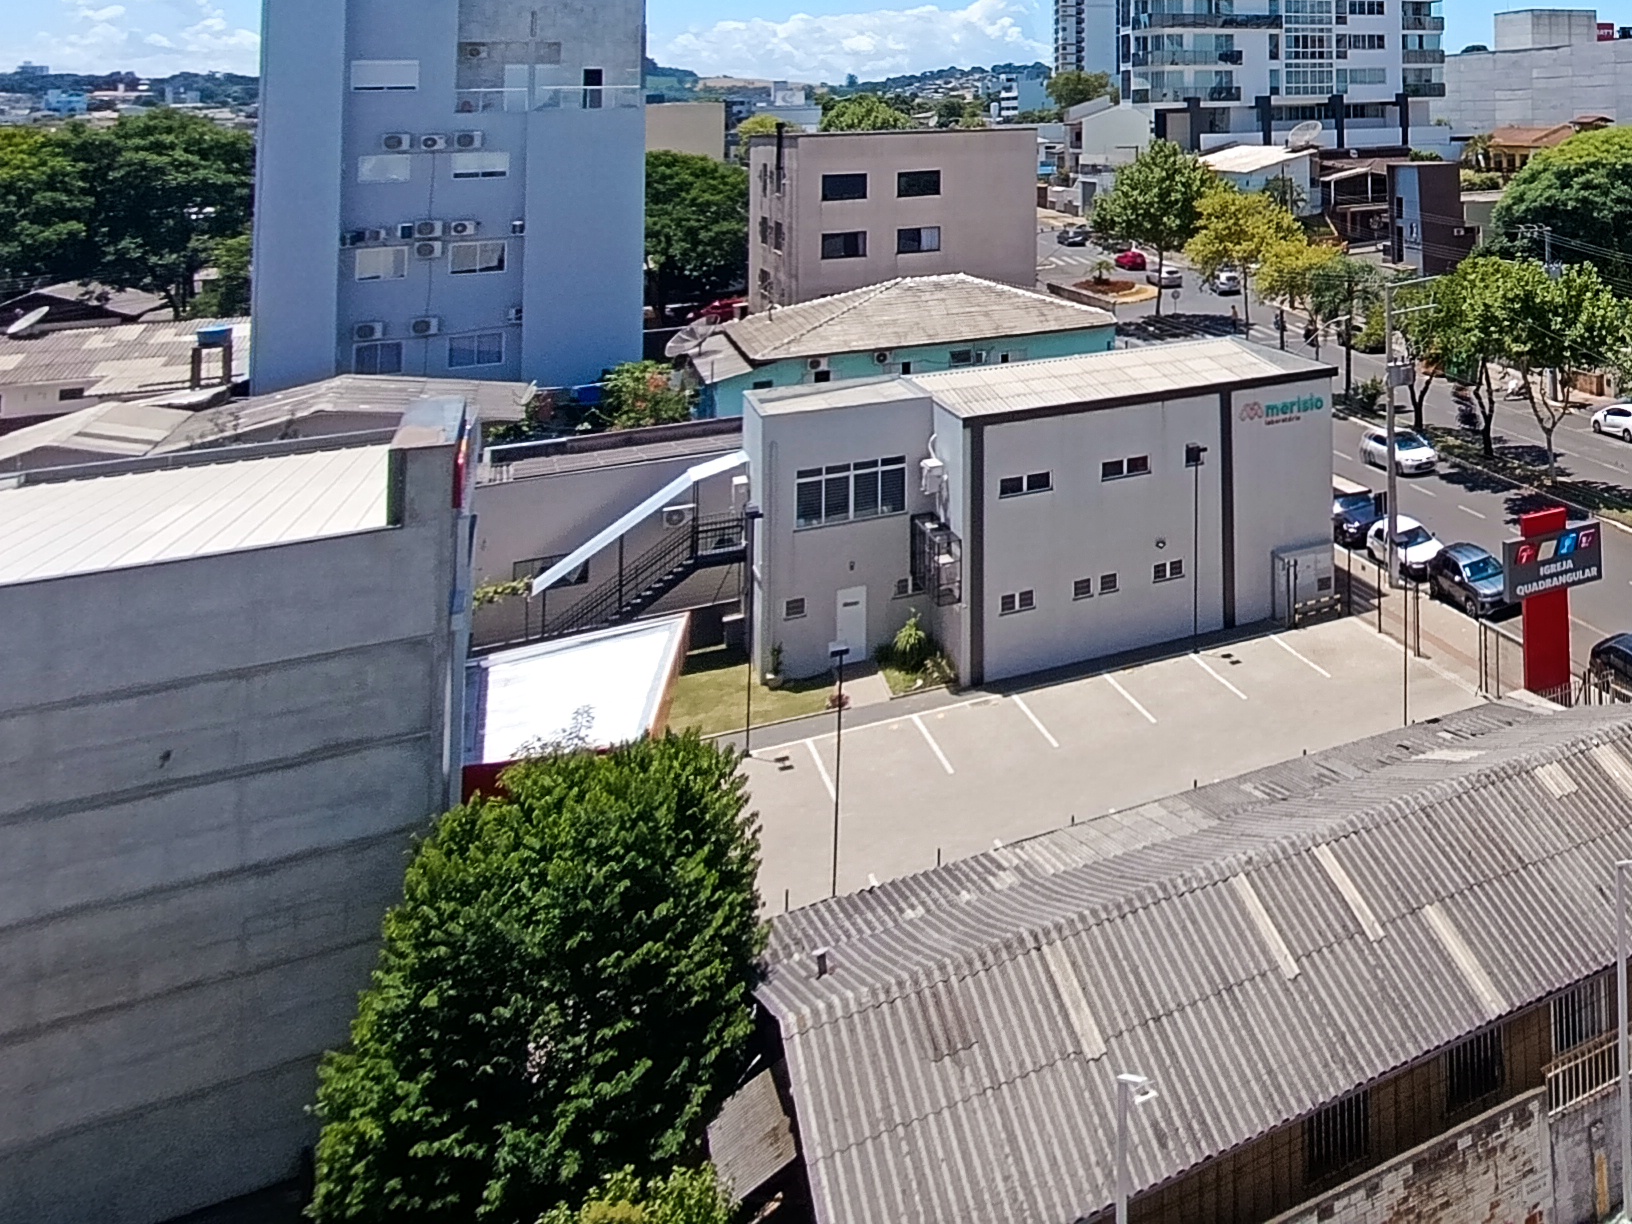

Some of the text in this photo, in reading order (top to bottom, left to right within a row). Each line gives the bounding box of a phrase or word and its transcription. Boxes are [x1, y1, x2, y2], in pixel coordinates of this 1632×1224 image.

[1265, 392, 1324, 417] merisio
[1540, 559, 1574, 576] IGREJA
[1516, 567, 1598, 596] QUADRANGULAR
